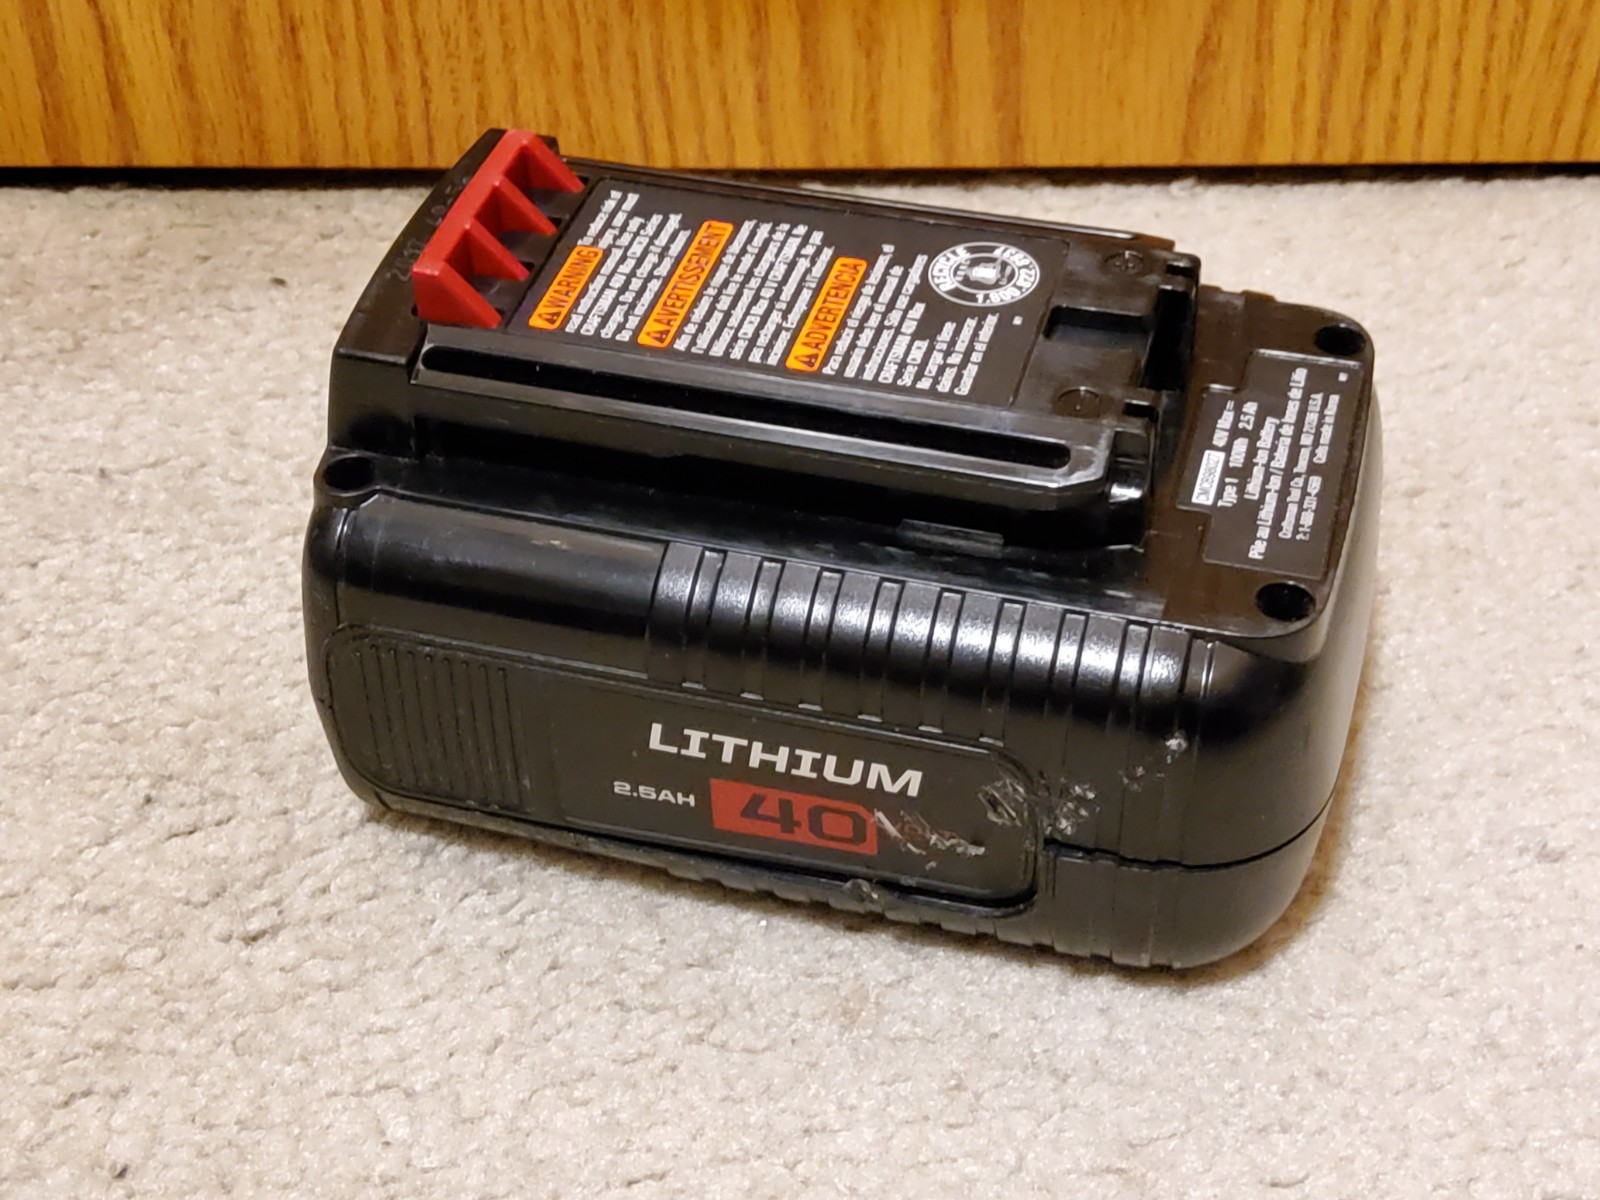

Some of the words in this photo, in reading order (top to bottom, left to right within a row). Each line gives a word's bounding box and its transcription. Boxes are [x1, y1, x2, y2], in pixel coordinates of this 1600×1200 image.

[542, 249, 599, 308] WARNING
[653, 223, 729, 327] AVERTISSEMENT
[932, 246, 971, 292] RECYCLE
[801, 262, 862, 352] ADVERTENCIA
[1217, 485, 1237, 507] Type
[1248, 539, 1267, 559] Pile
[648, 722, 923, 797] LITHIUM
[612, 781, 696, 808] 2.5AH
[739, 793, 867, 847] 40
